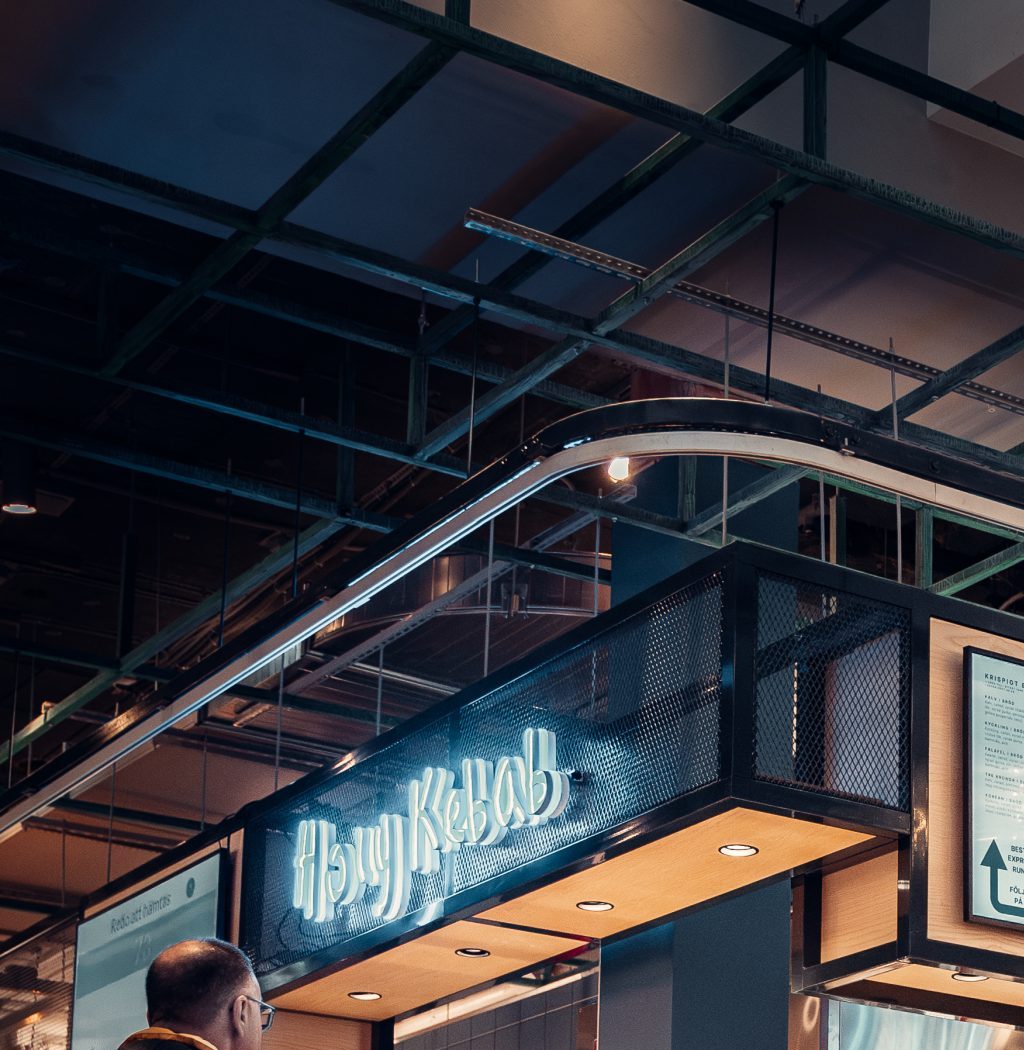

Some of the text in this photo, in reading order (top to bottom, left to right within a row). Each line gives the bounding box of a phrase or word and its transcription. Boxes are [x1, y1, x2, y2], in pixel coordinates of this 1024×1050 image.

[409, 727, 570, 875] Kebab
[1009, 884, 1024, 894] FÖLJ
[1014, 896, 1022, 904] PÅ
